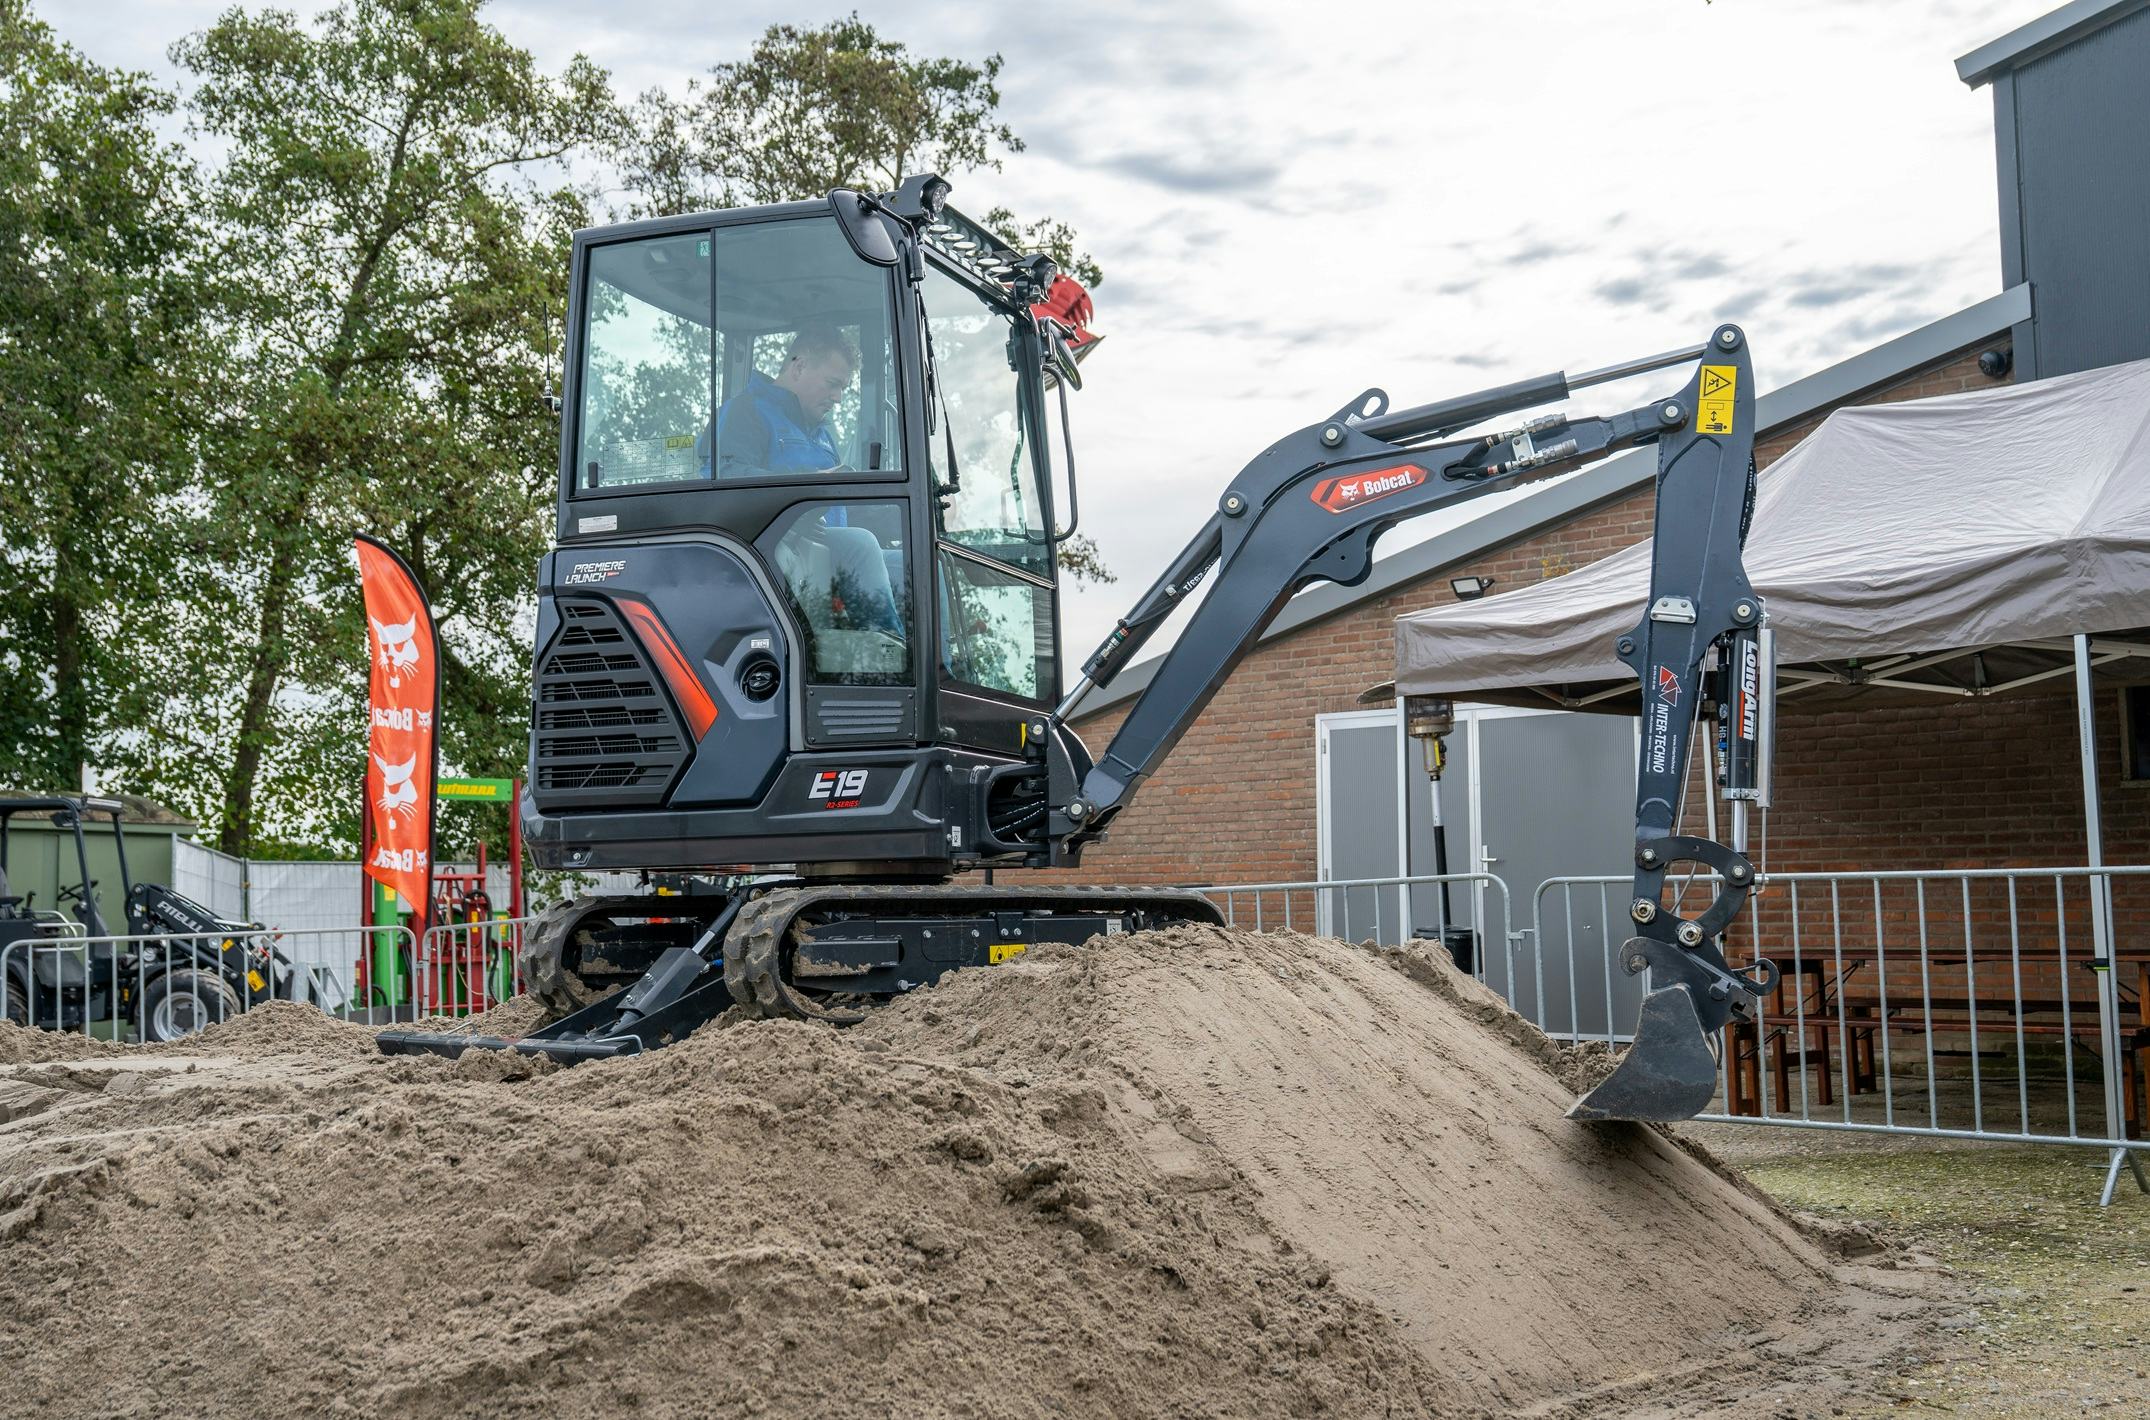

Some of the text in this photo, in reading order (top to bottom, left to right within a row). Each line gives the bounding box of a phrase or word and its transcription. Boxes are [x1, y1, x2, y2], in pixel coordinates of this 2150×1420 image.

[1363, 471, 1412, 496] Bobcat
[565, 572, 607, 585] LAUNCH
[574, 560, 626, 574] PREMIERE
[1743, 640, 1758, 740] LongArm
[1653, 703, 1669, 773] INTER-TECHNO
[809, 769, 869, 799] E19
[826, 800, 859, 809] R2-SERIES
[157, 901, 203, 933] PITBULL
